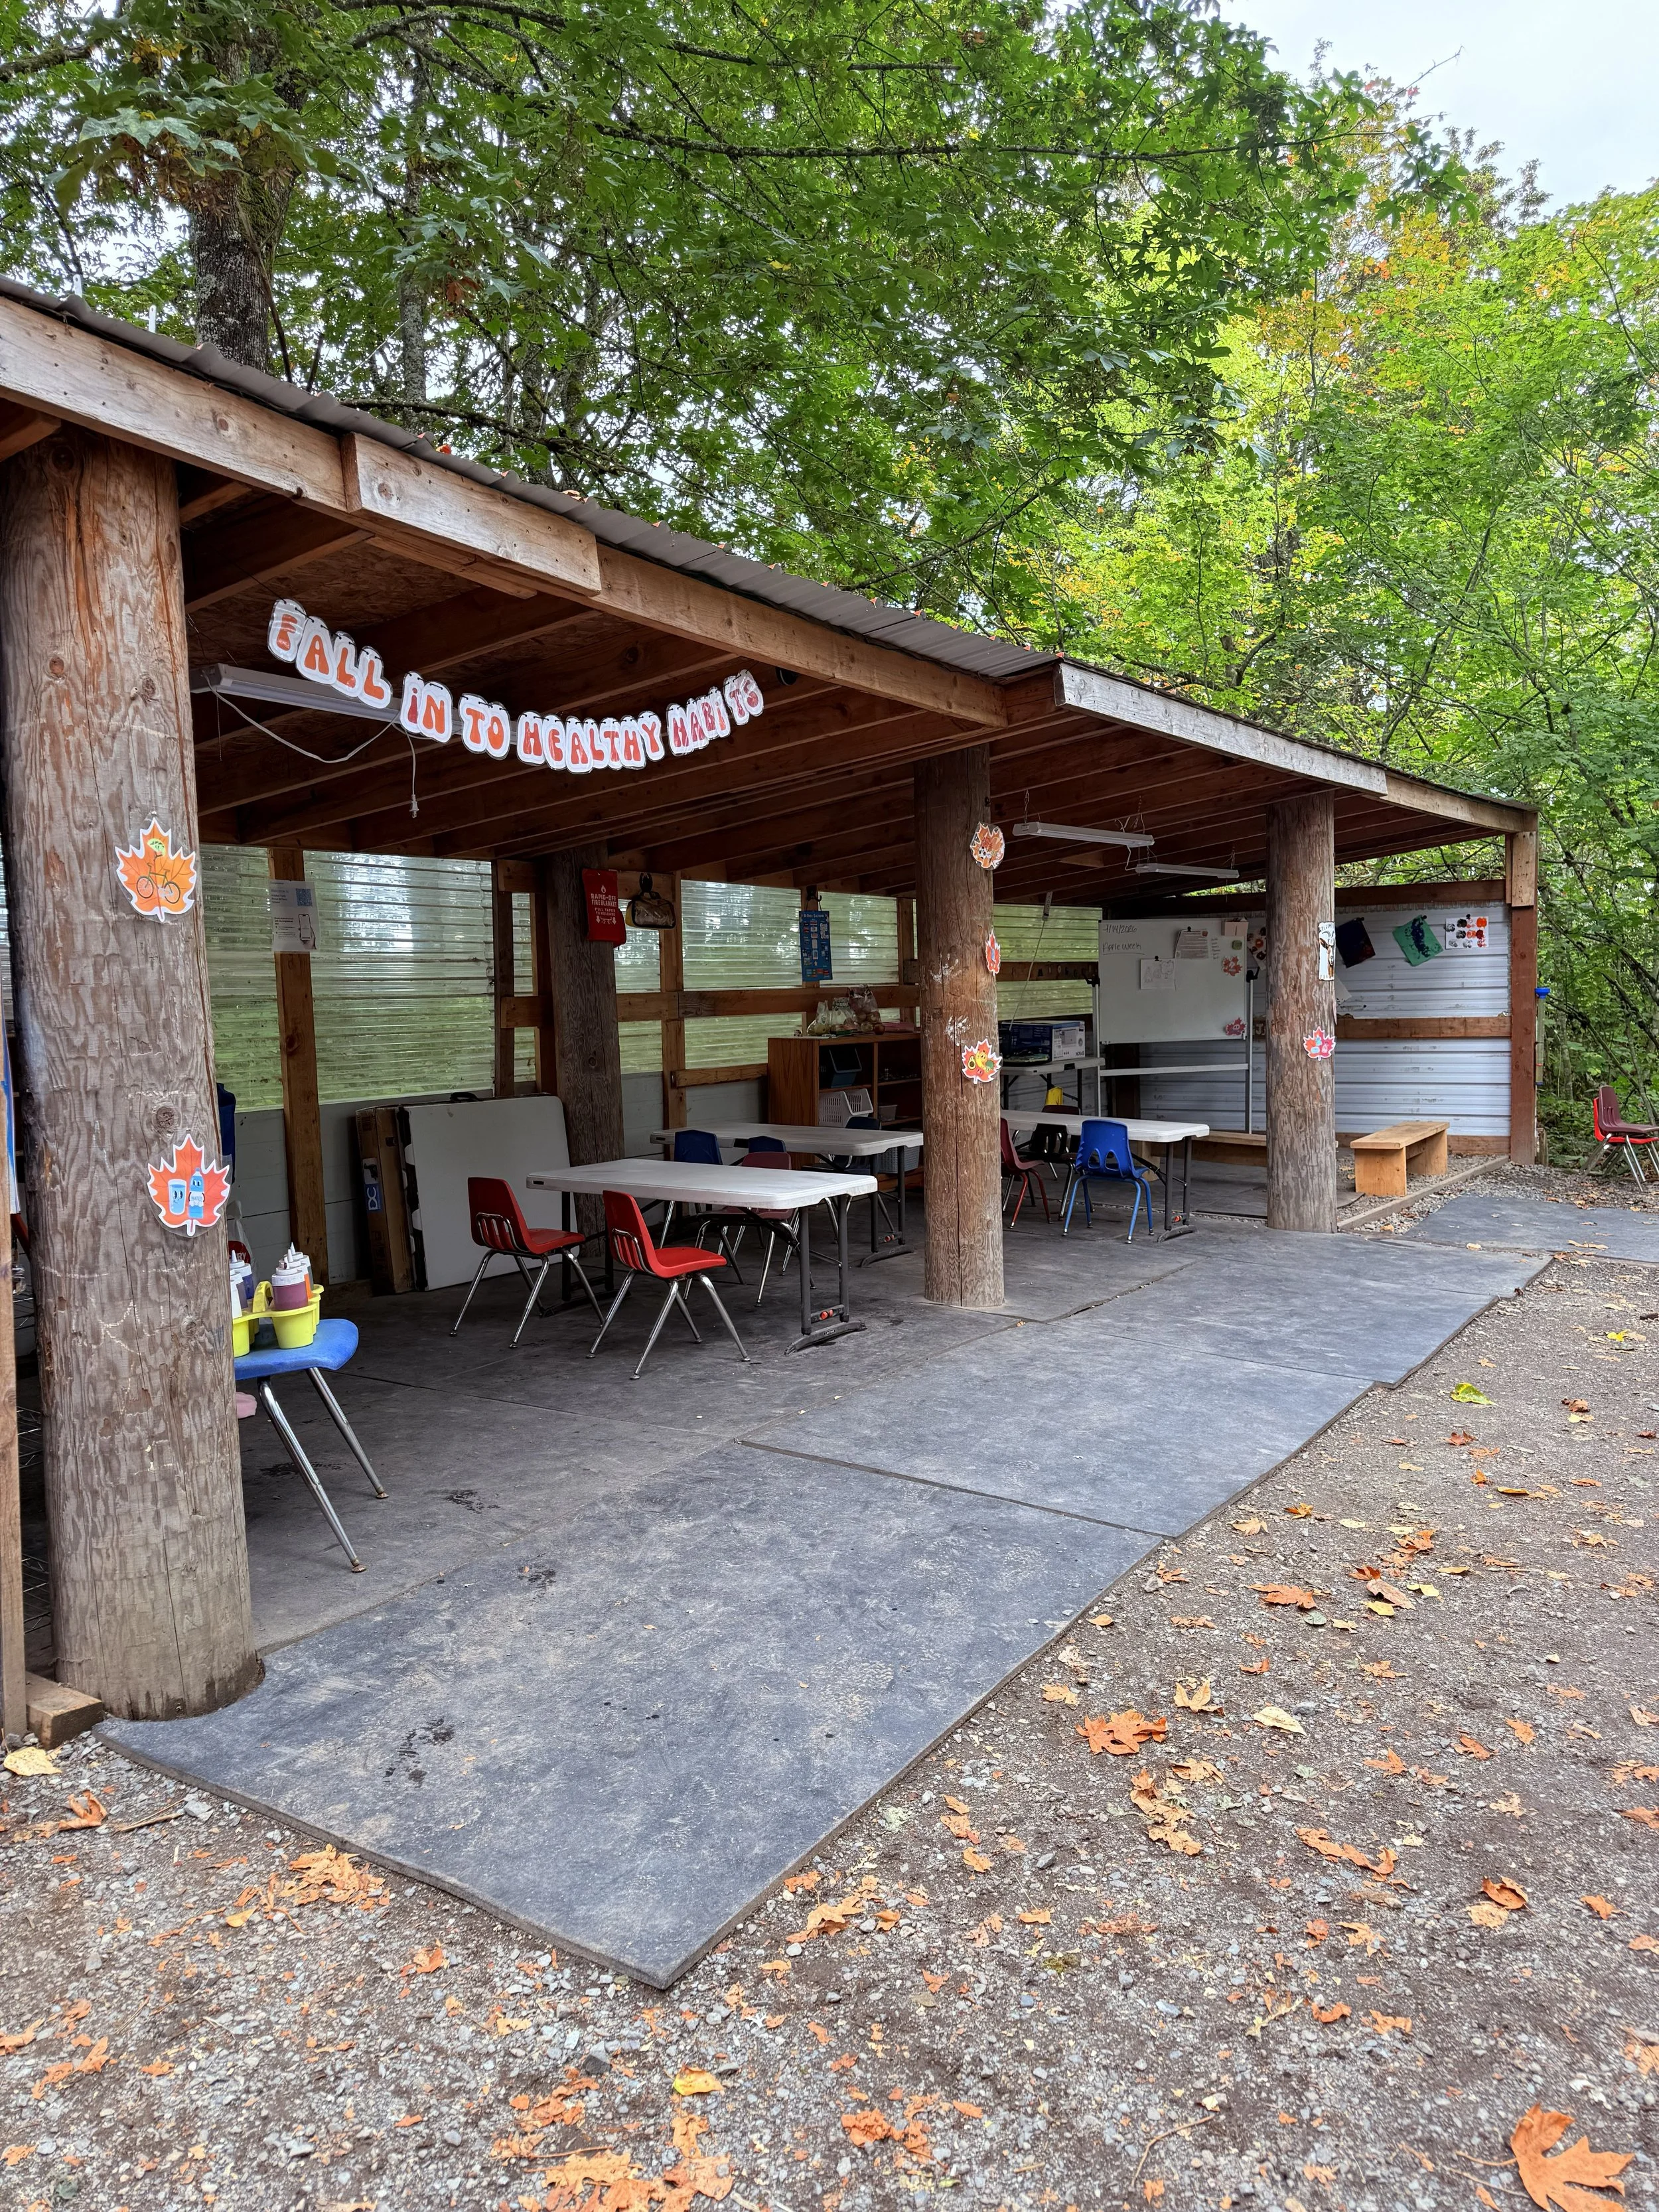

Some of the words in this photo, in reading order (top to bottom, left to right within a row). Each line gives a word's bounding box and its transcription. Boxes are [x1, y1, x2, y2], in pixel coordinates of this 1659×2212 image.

[276, 613, 385, 700] FALL
[465, 707, 504, 750] TO
[522, 721, 660, 765] HEALTHY
